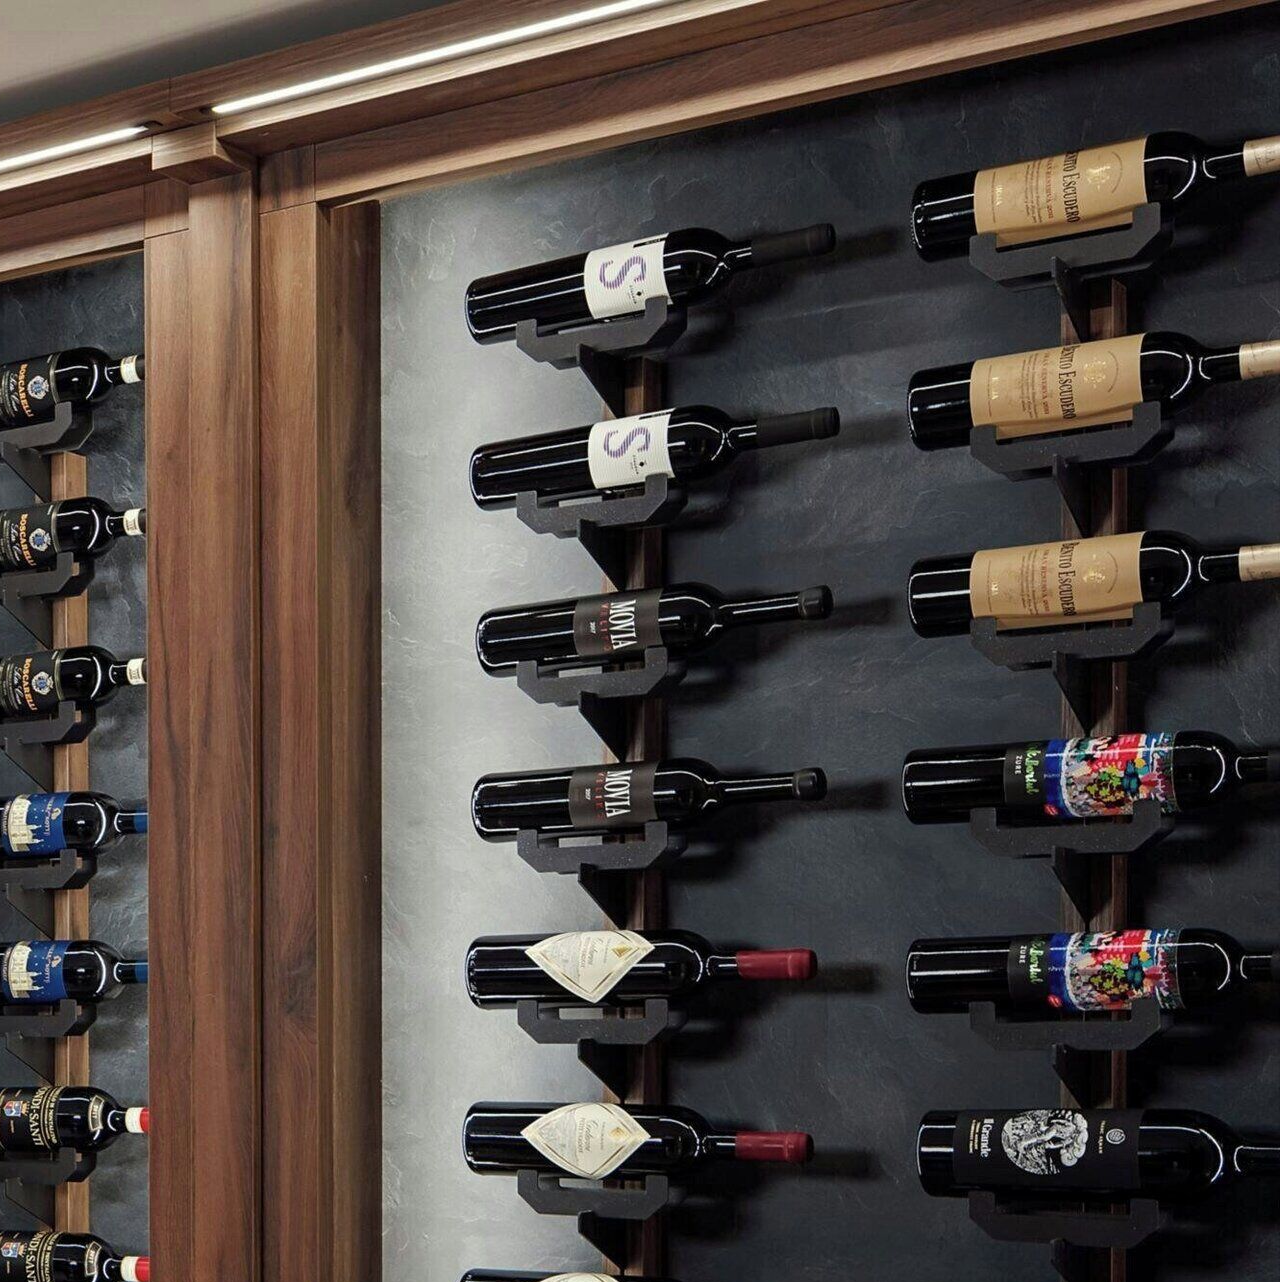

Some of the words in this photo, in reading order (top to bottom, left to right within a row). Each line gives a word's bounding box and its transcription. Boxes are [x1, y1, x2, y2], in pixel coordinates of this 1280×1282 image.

[1062, 172, 1081, 223] ESCUDERO
[600, 256, 647, 290] S
[18, 363, 34, 418] BOSCARELLI
[1059, 370, 1078, 420] ESCUDERO
[604, 427, 651, 459] S
[20, 513, 37, 567] BOSCARELLI
[1058, 570, 1077, 616] ESCUDERO
[609, 599, 638, 650] MOVIA
[22, 658, 38, 711] BOSCARELLI
[1014, 755, 1023, 774] ZURE
[604, 769, 633, 818] MOVIA
[1019, 945, 1027, 963] ZURE
[980, 1124, 993, 1158] Grande
